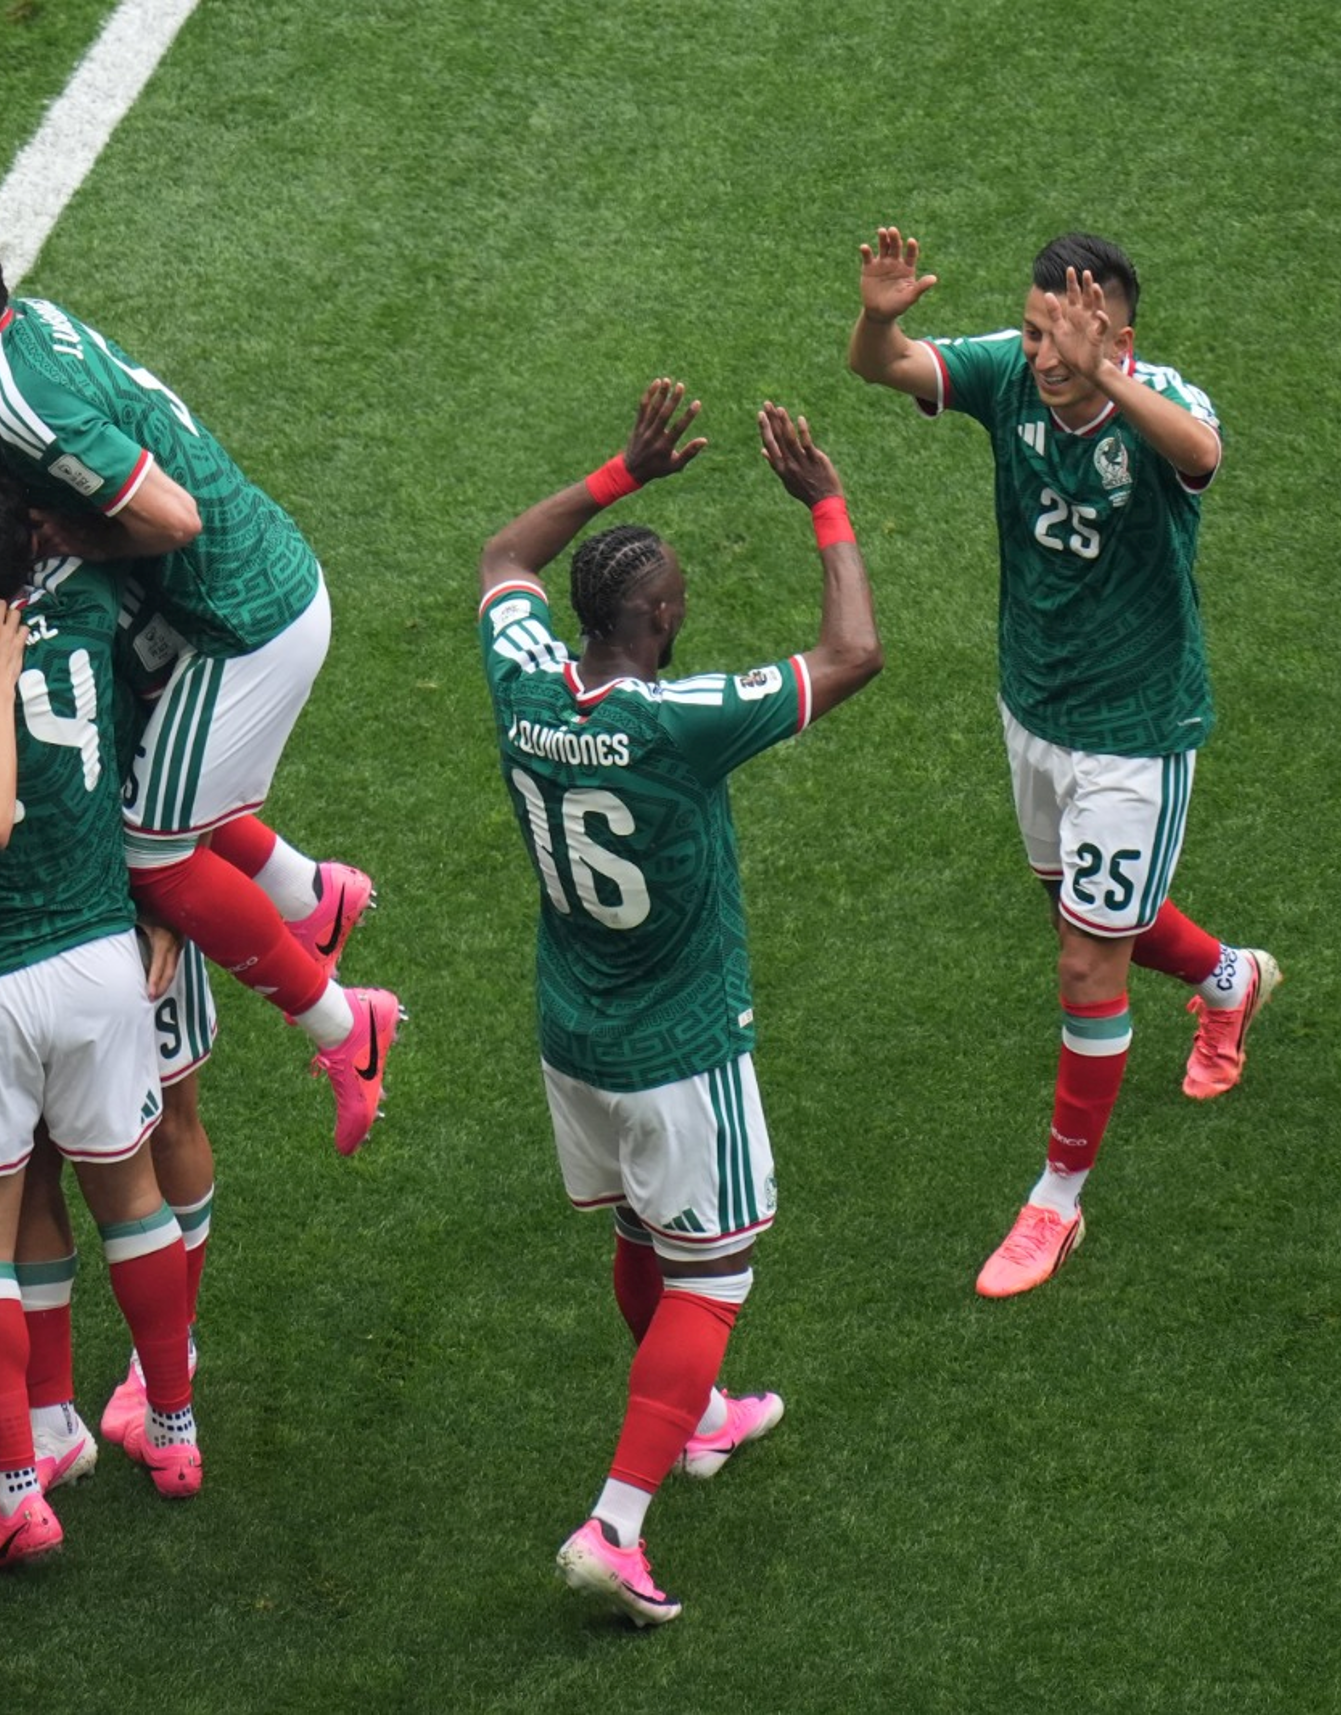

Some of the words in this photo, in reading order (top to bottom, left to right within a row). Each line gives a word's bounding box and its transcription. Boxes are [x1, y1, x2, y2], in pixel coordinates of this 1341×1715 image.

[1035, 488, 1100, 559] 25
[511, 768, 651, 929] 16
[1072, 842, 1141, 911] 25
[155, 997, 182, 1060] 9
